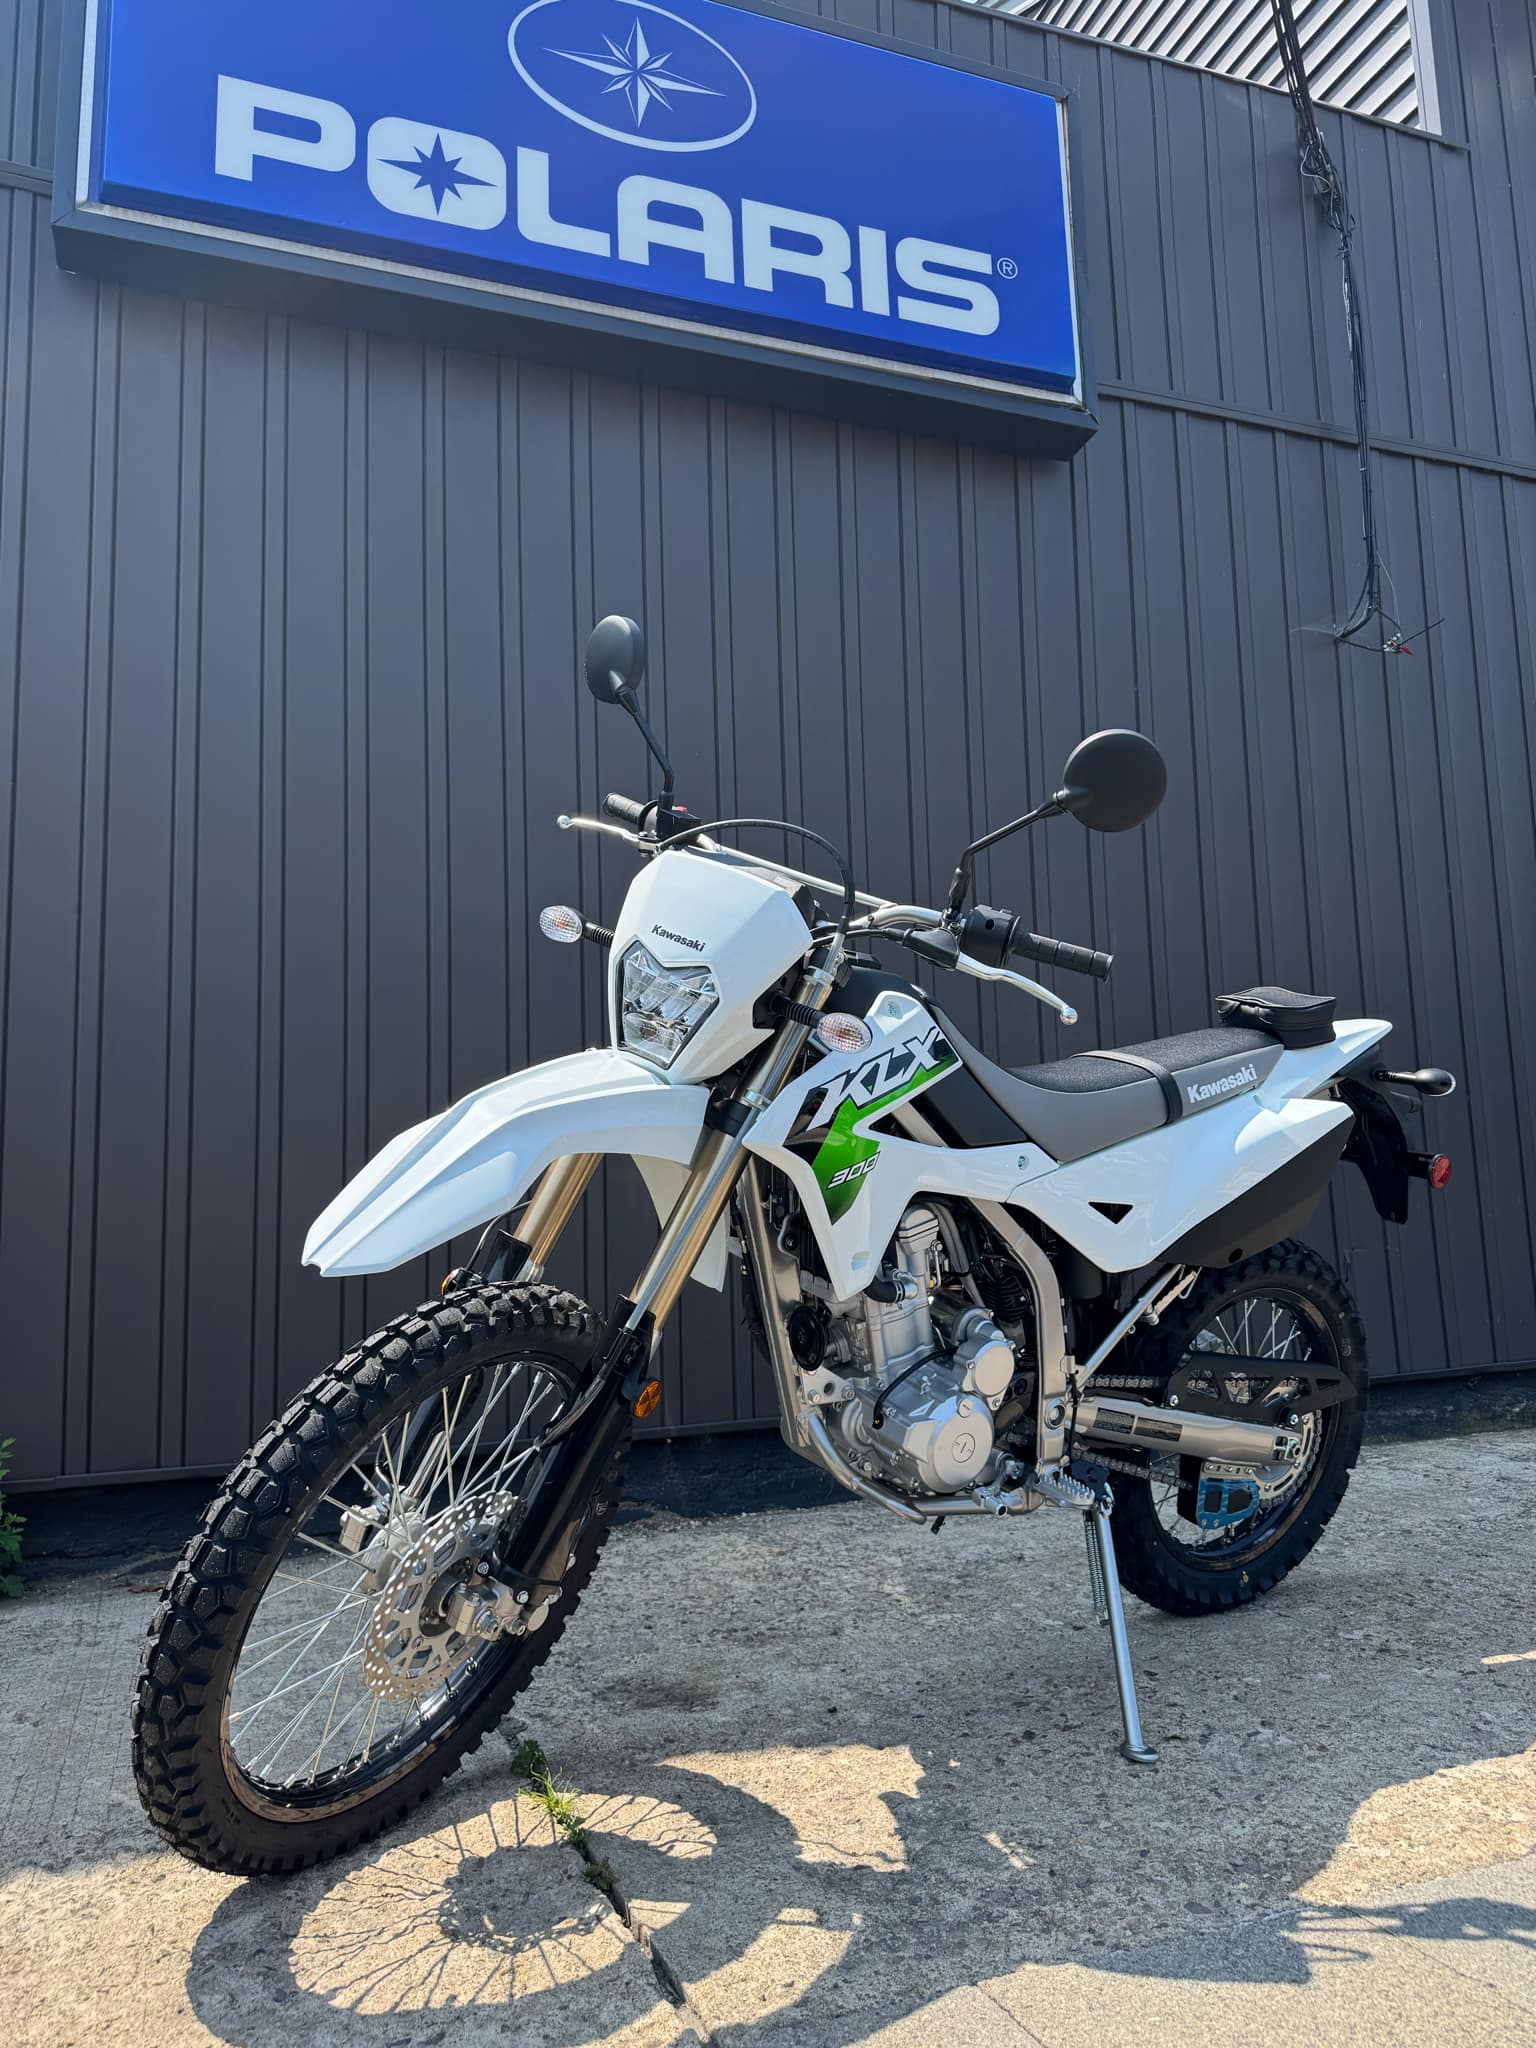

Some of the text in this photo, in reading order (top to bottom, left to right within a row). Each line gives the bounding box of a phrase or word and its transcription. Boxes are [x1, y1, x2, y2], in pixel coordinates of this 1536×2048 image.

[651, 924, 706, 952] Kawasaki
[805, 1025, 944, 1133] KLX
[1187, 1063, 1257, 1104] Kawasaki
[826, 1151, 881, 1190] 300
